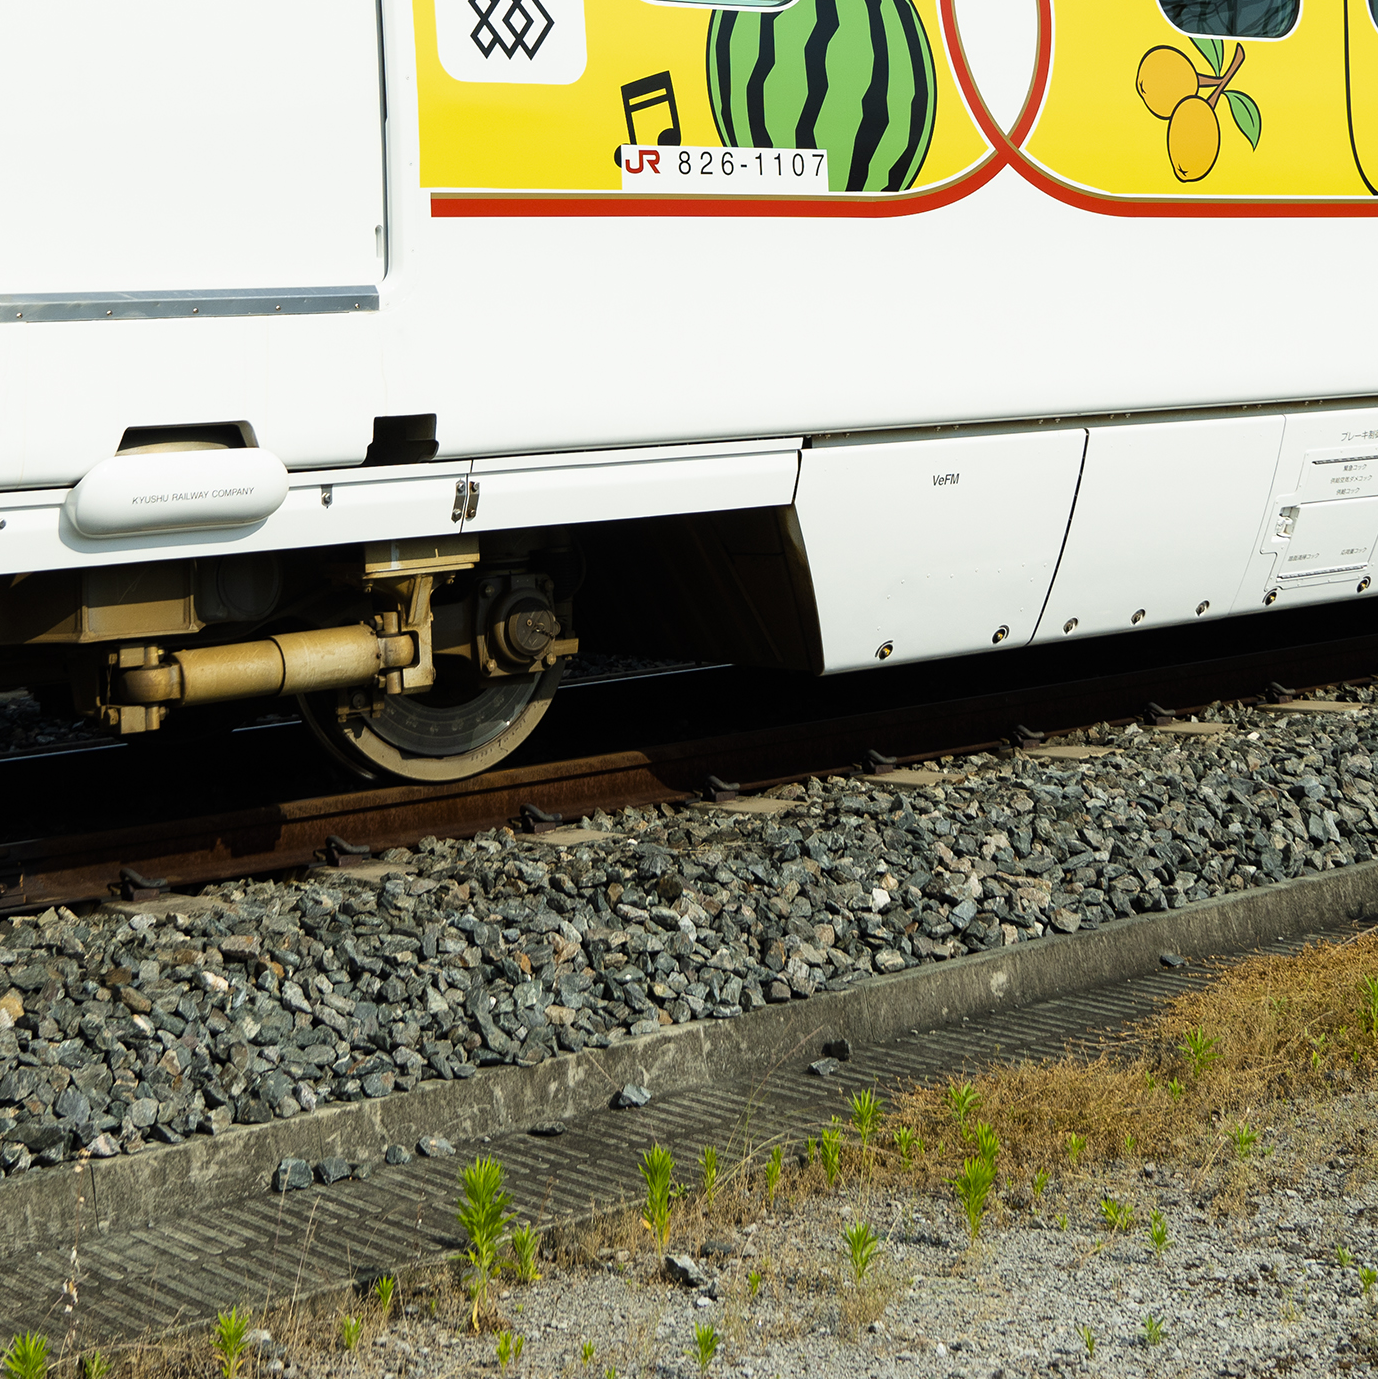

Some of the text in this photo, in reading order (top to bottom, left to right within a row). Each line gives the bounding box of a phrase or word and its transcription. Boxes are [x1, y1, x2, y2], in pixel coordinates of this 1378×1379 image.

[625, 150, 825, 177] JR 826-1107
[932, 472, 960, 486] VeFM
[132, 487, 255, 504] KYUSHU RAILWAY COMPANY
